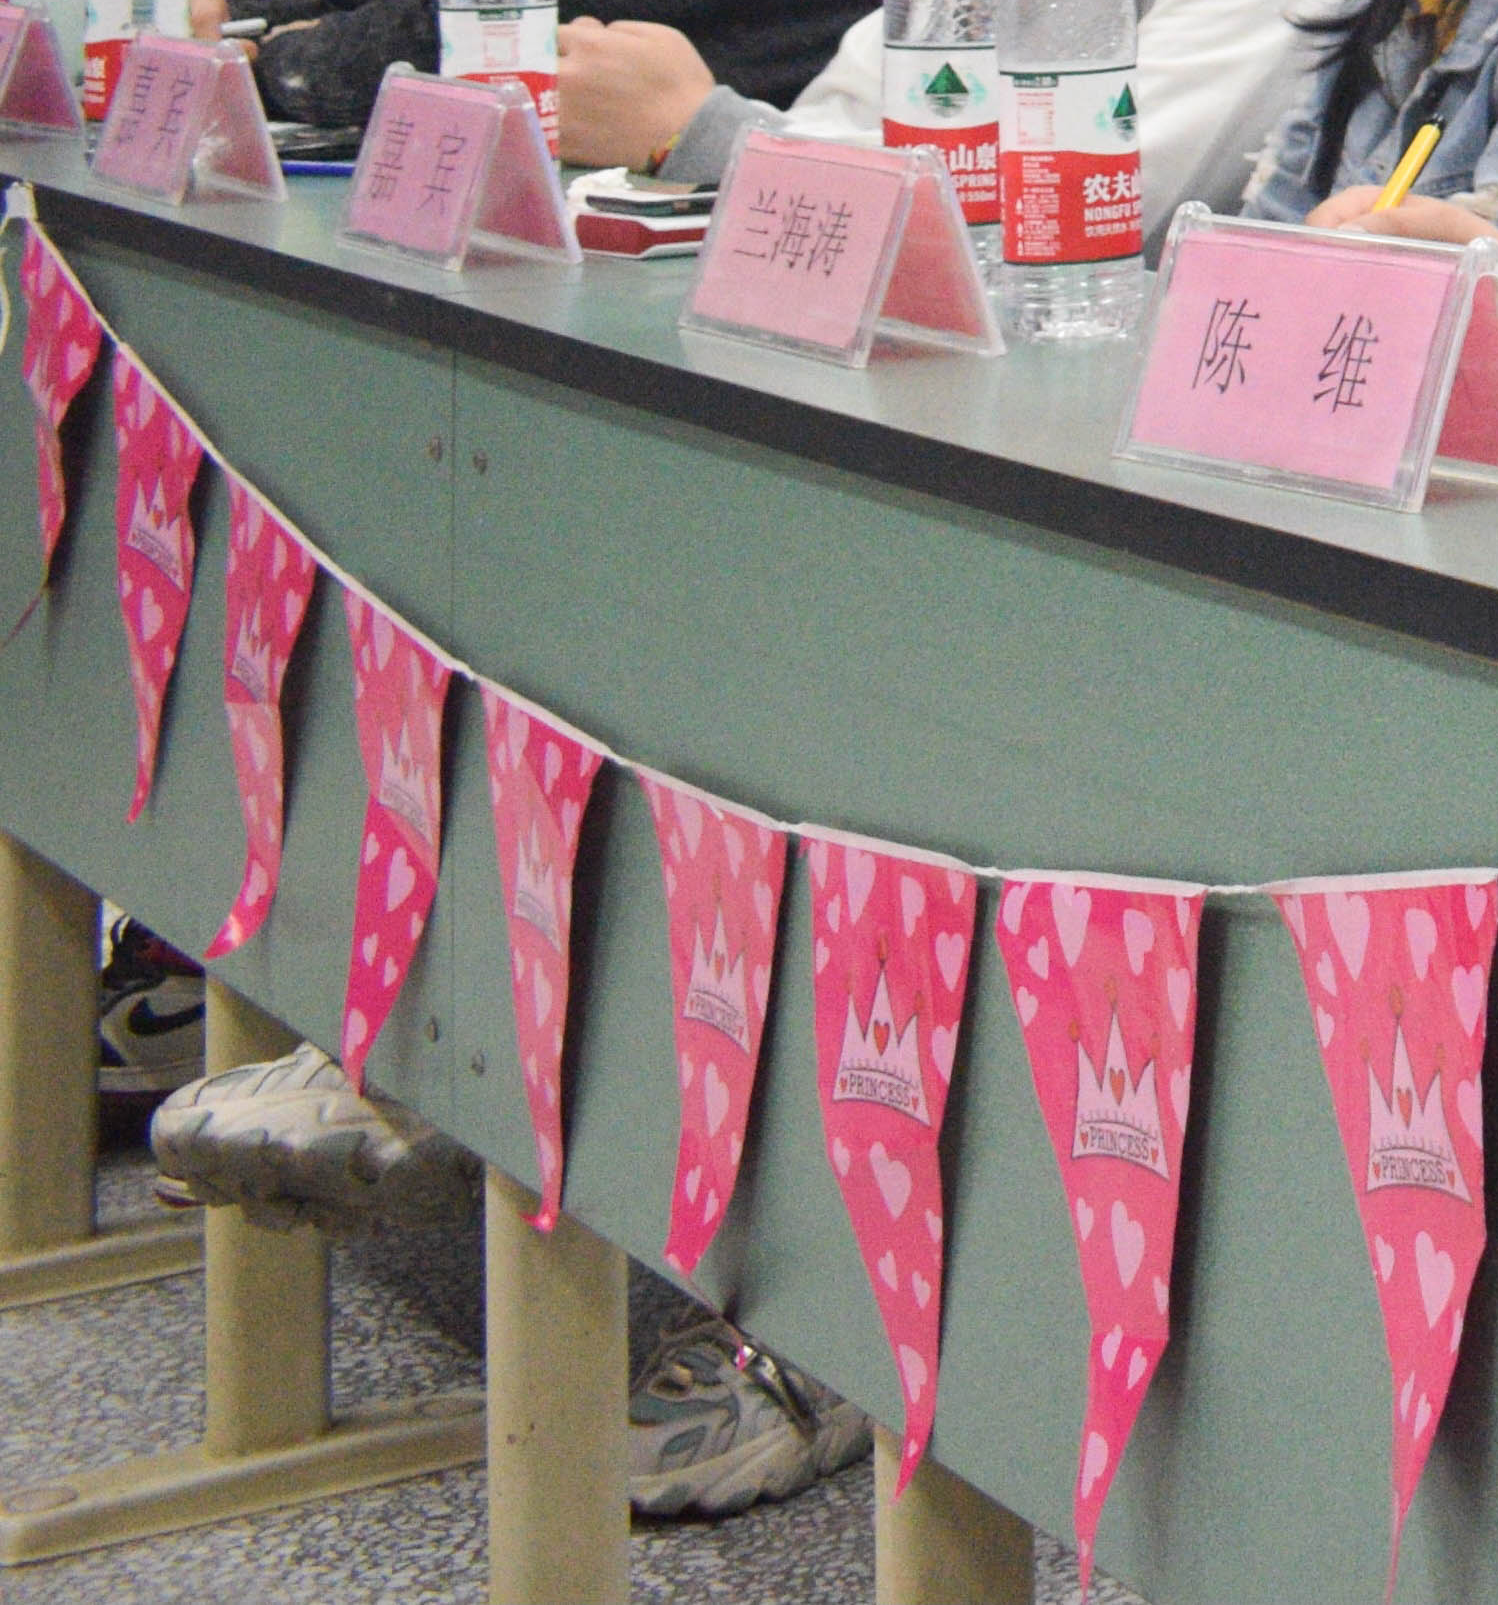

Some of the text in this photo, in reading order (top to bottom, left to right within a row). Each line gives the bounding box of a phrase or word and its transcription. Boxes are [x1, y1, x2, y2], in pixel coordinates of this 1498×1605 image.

[732, 189, 853, 278] 兰海涛
[848, 1073, 911, 1107] PRINCESS
[1089, 1125, 1150, 1162] PRINCESS
[1381, 1155, 1447, 1184] PRINCESS
